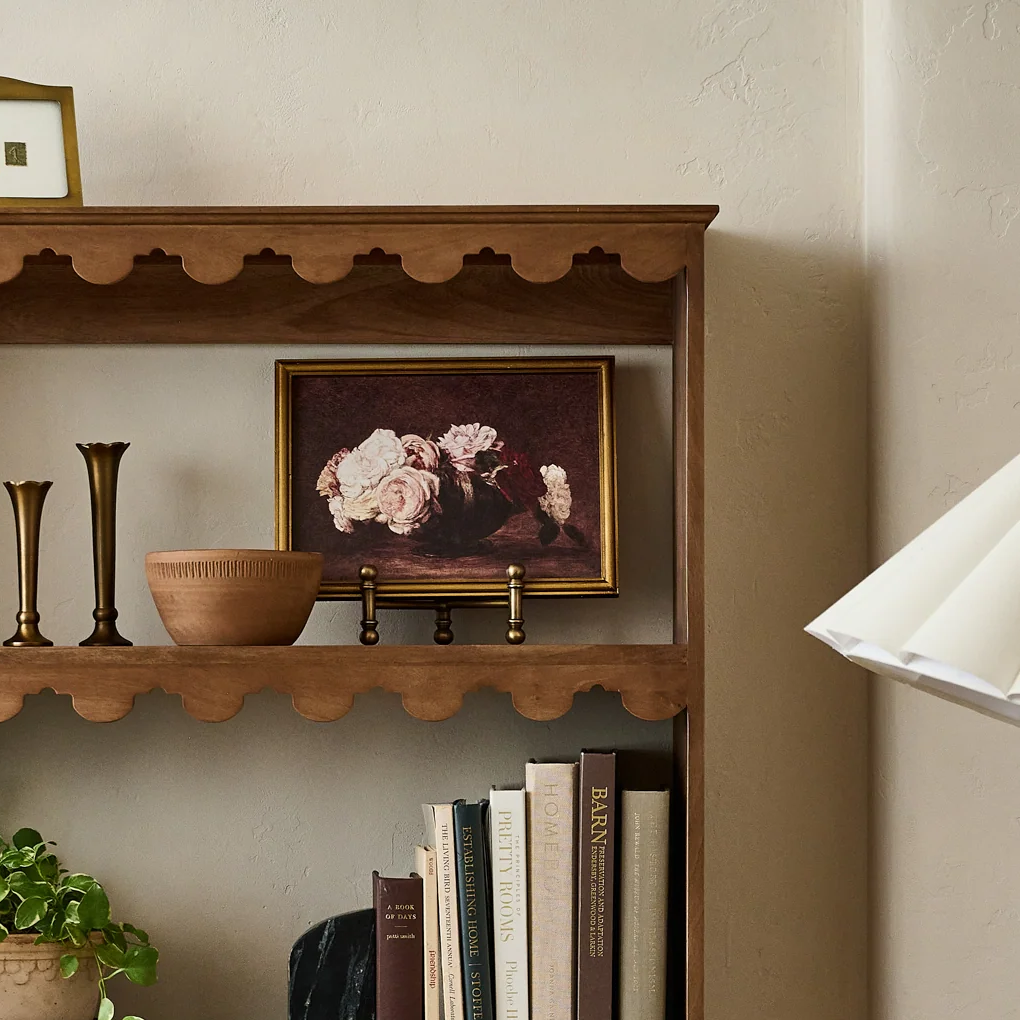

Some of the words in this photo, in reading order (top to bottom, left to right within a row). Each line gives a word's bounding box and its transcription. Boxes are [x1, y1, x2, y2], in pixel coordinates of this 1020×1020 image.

[441, 823, 449, 841] THE
[591, 787, 608, 845] BARN
[442, 843, 450, 871] LIVING
[498, 811, 513, 876] PRETTY
[462, 826, 477, 916] ESTABLISHING
[590, 846, 598, 882] ENDERSBY,
[499, 881, 515, 943] ROOMS
[515, 908, 521, 917] OF
[597, 898, 605, 912] AND
[467, 920, 480, 958] HOME
[448, 973, 456, 994] Cornell
[505, 961, 519, 1006] Phoebe
